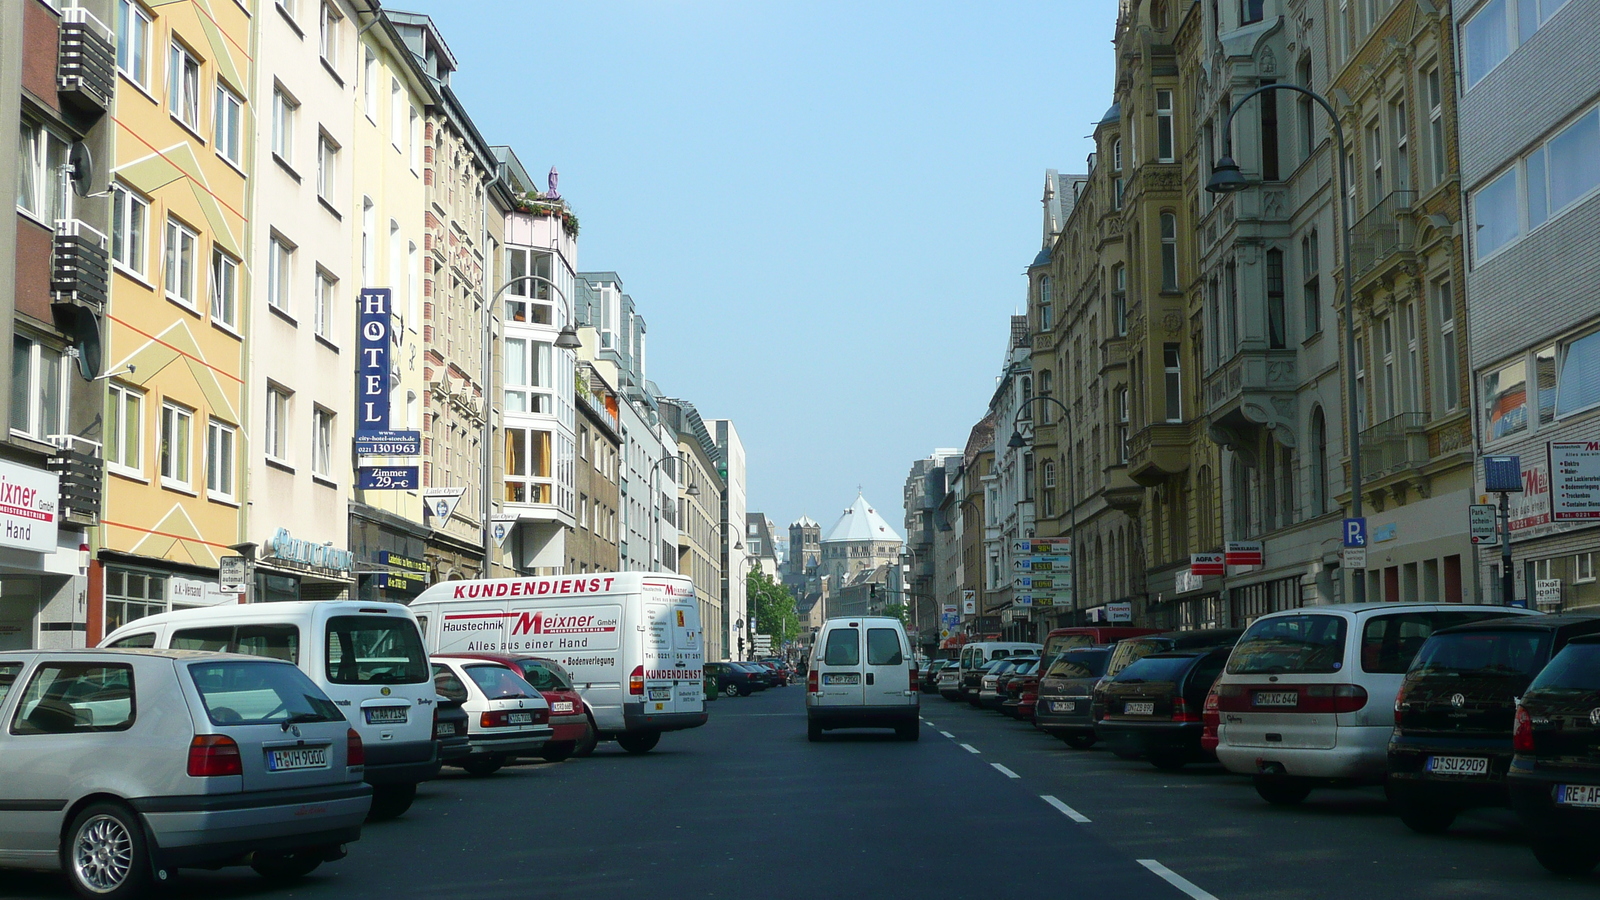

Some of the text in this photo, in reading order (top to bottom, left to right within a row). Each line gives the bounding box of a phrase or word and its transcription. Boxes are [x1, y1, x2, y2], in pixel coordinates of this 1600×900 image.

[363, 294, 387, 423] HOTEL
[358, 434, 416, 443] city-hotel-storch.de
[373, 443, 416, 454] 1301963
[372, 468, 408, 478] Zimmer
[39, 499, 54, 513] GmbH
[1511, 519, 1527, 529] 0221
[1536, 516, 1545, 525] 56
[6, 519, 31, 541] Hand
[1348, 521, 1361, 544] P
[453, 578, 615, 599] KUNDENDIENST
[443, 611, 617, 636] Haustechnik Meixner GmbH
[468, 635, 588, 651] Alles aus einer Hand
[567, 656, 615, 667] Bodenverlegung
[645, 669, 702, 679] KUNDENDIENST
[1271, 694, 1281, 704] XC
[1282, 694, 1297, 704] 644
[275, 752, 283, 767] H
[302, 750, 325, 766] 9000
[1432, 757, 1440, 769] D
[1565, 787, 1579, 801] RE
